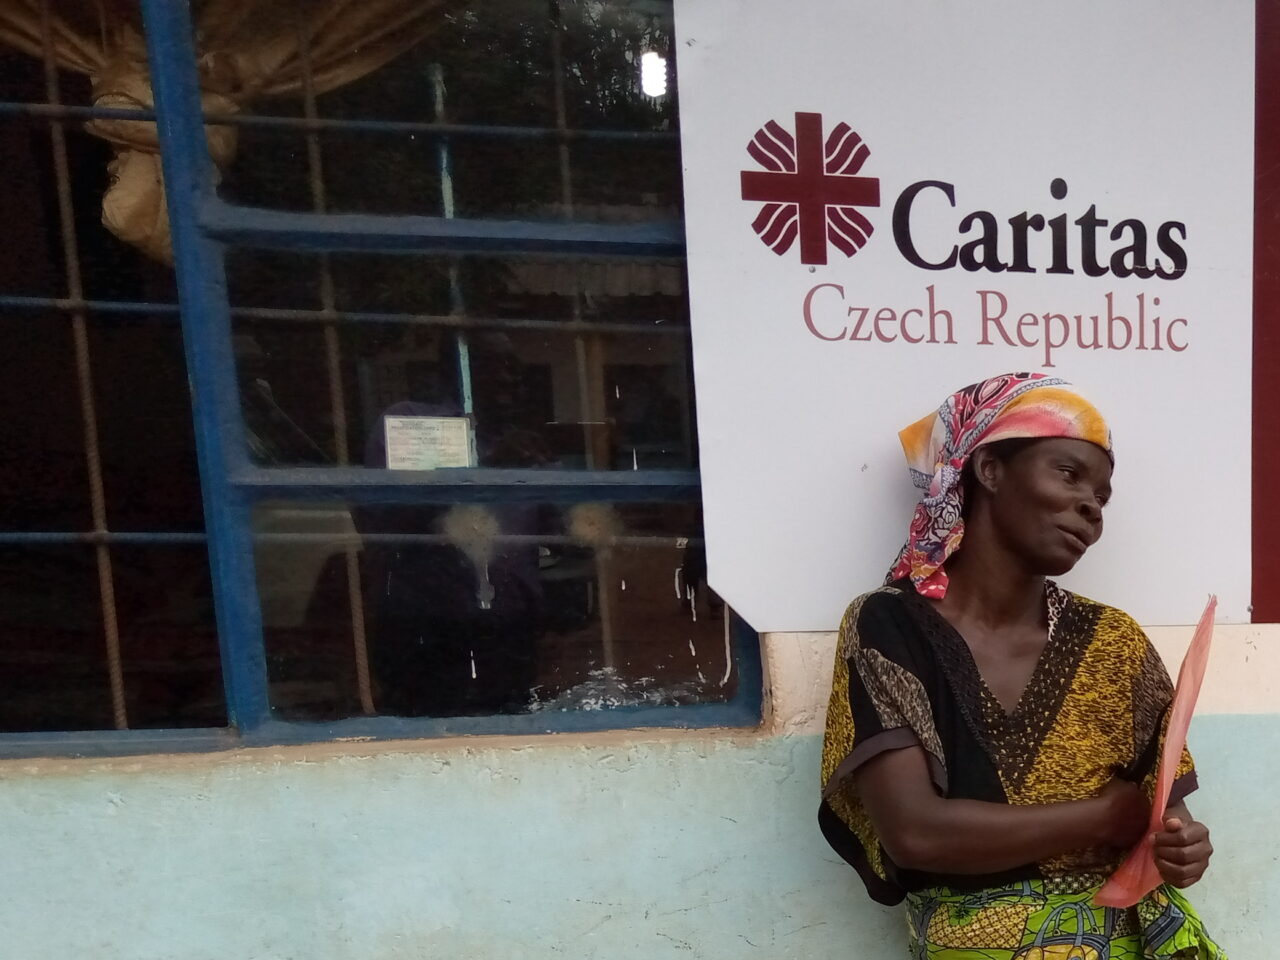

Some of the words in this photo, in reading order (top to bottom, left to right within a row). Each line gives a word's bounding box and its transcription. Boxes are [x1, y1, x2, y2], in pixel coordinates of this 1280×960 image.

[891, 177, 1188, 281] Caritas
[803, 282, 958, 345] Czech
[976, 290, 1189, 367] Republic
